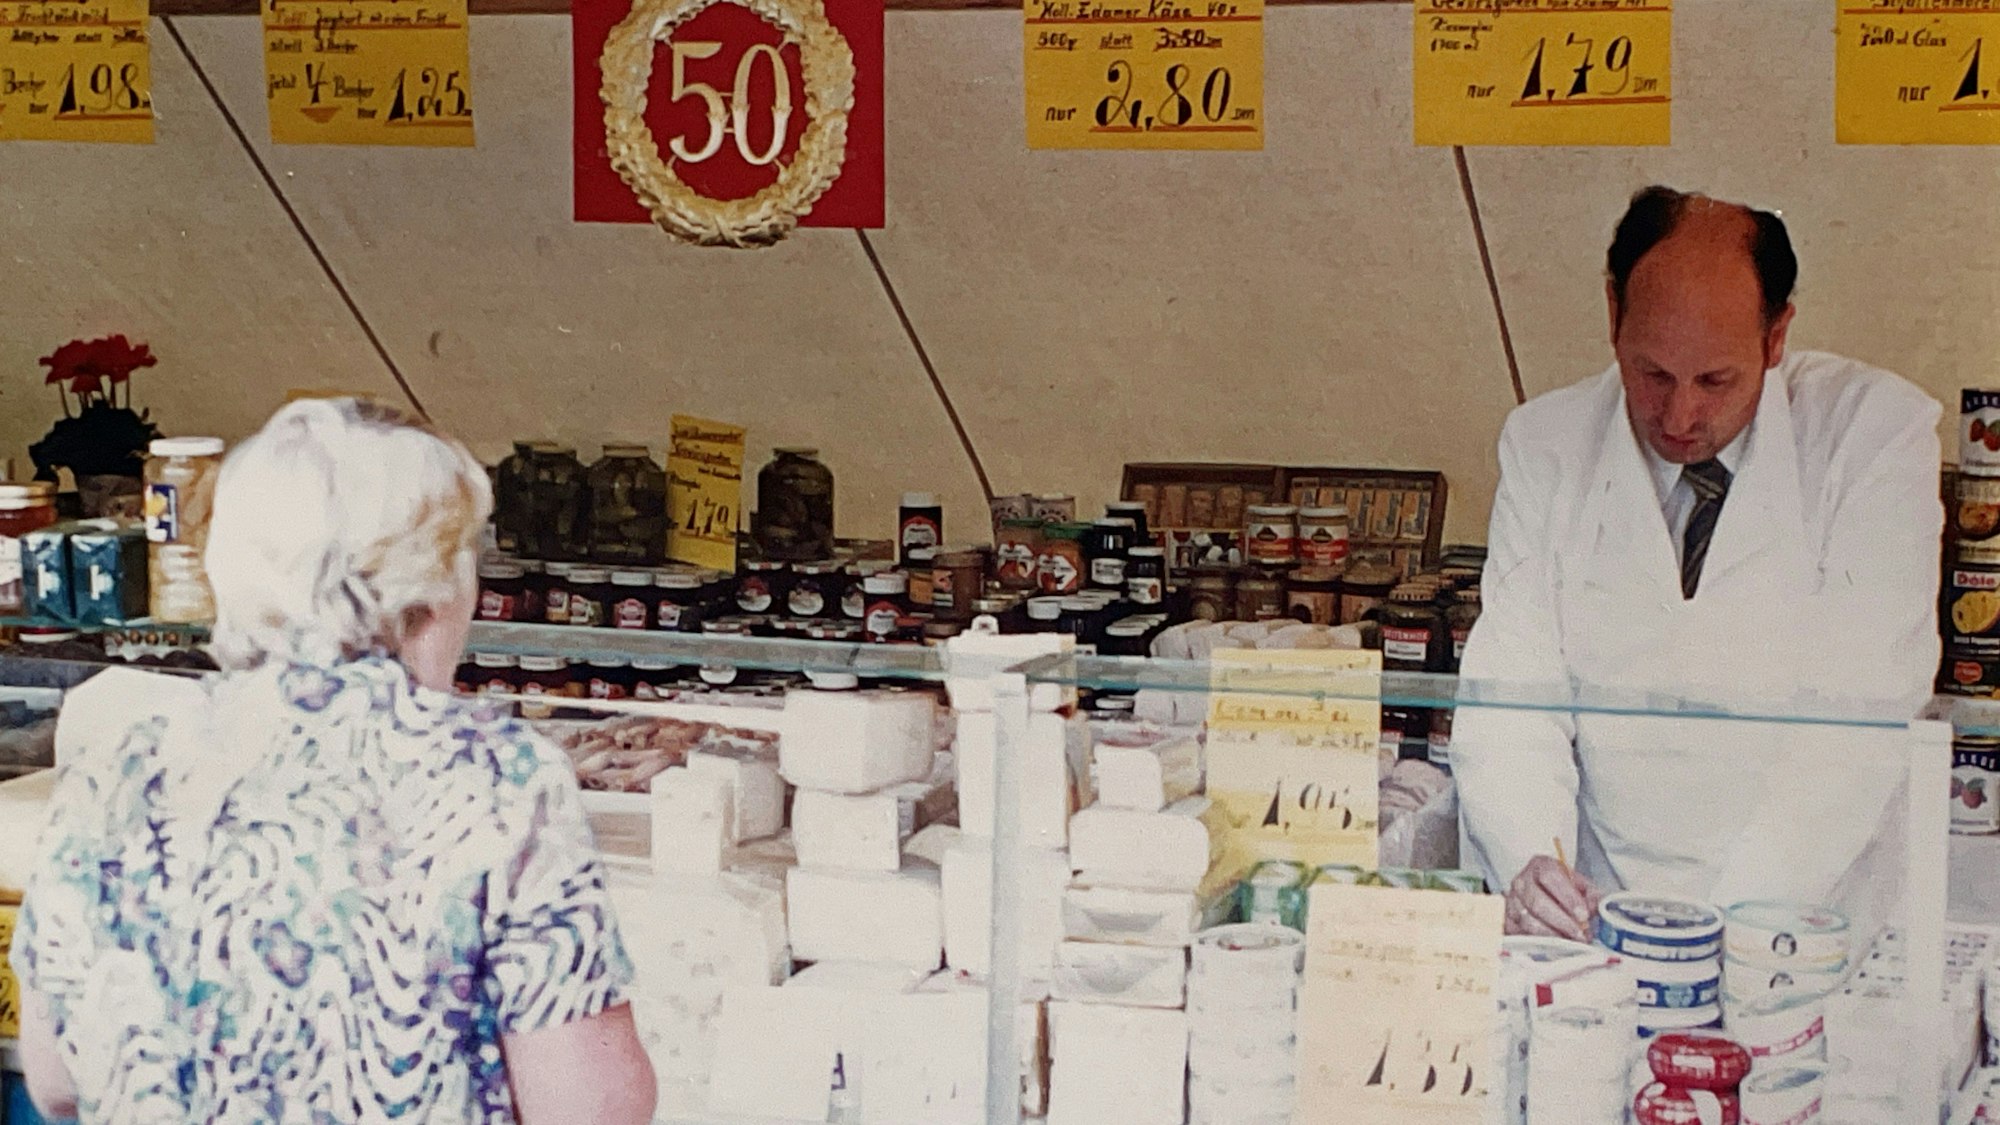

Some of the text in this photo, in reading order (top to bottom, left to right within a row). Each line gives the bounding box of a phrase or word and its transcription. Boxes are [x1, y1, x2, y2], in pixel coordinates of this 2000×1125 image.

[1077, 2, 1142, 19] Edamer
[1148, 0, 1193, 18] Käse
[1912, 27, 1947, 48] Glas
[305, 61, 329, 104] 4
[1466, 85, 1496, 99] nur
[1519, 32, 1633, 104] 1,79
[388, 67, 466, 122] 1,25
[669, 41, 793, 166] 50
[1045, 106, 1077, 122] nur
[1095, 59, 1232, 132] 2,80
[1897, 85, 1932, 103] nur
